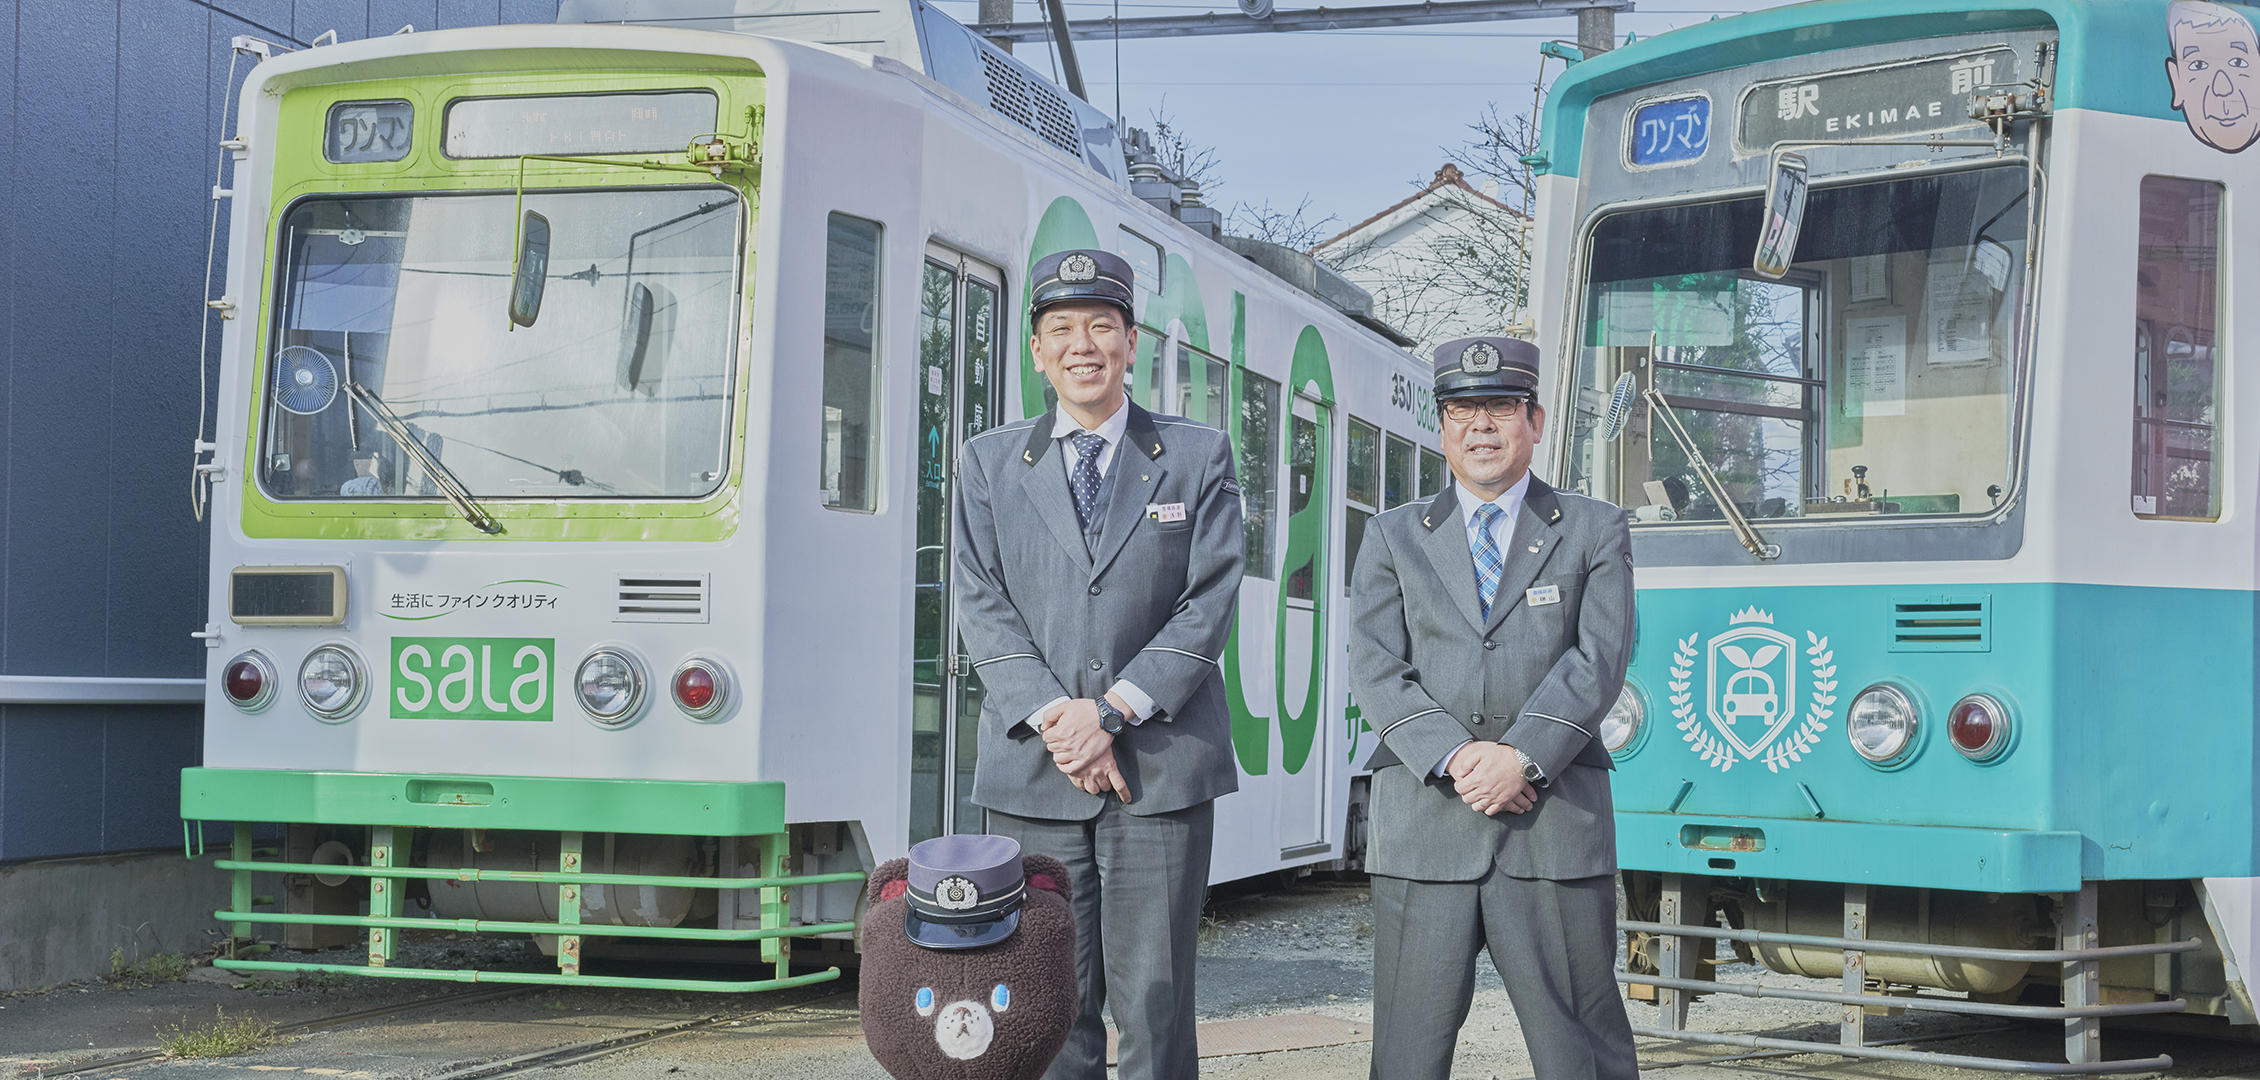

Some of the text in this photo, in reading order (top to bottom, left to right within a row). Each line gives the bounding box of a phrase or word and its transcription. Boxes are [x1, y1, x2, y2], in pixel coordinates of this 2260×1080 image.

[1826, 101, 1942, 132] EKIMAE
[340, 116, 411, 153] ワンマン
[1642, 112, 1710, 156] ワンマン
[925, 460, 941, 480] 入口
[391, 593, 558, 609] 生活に ファイン クオリティ
[396, 644, 548, 714] sala
